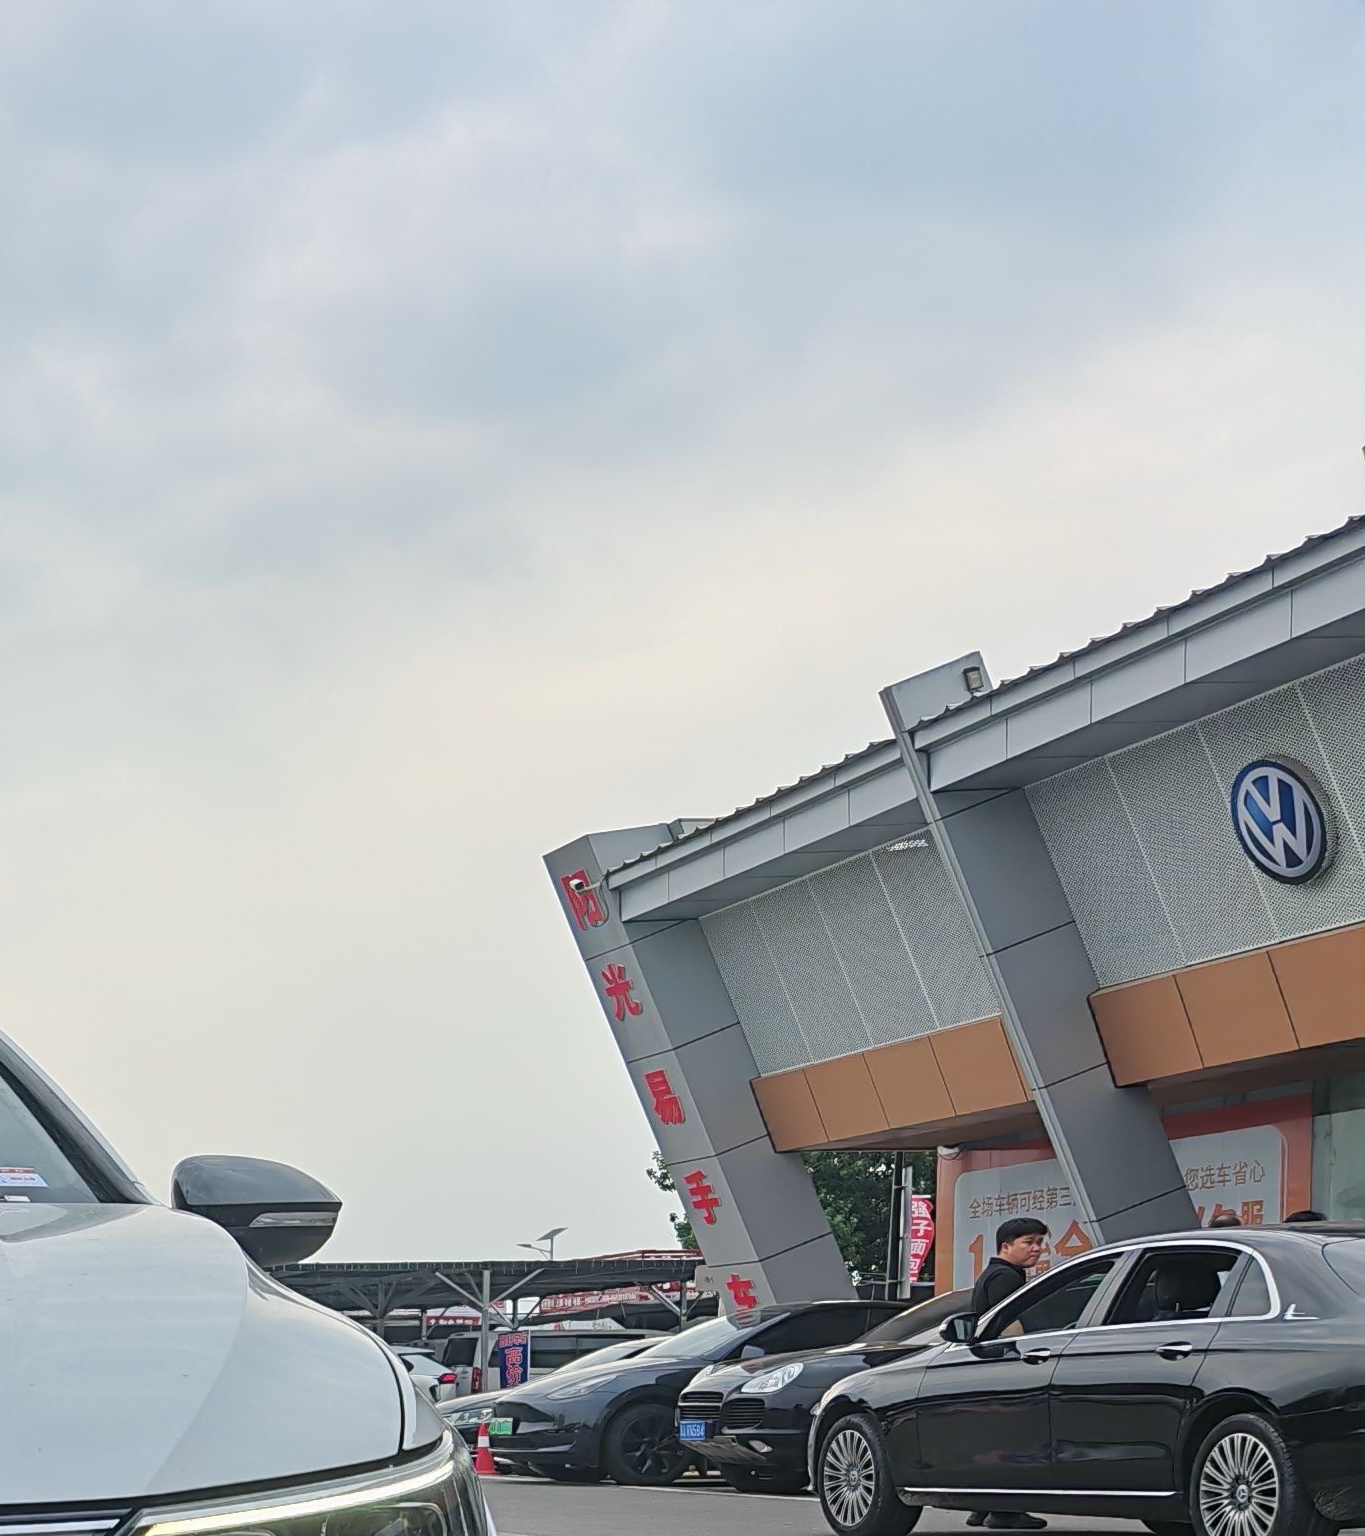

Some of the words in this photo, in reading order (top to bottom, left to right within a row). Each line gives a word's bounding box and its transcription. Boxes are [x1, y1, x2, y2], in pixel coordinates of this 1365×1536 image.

[969, 1187, 1076, 1219] 全场车辆可经第三
[1184, 1160, 1265, 1191] 您选车省心
